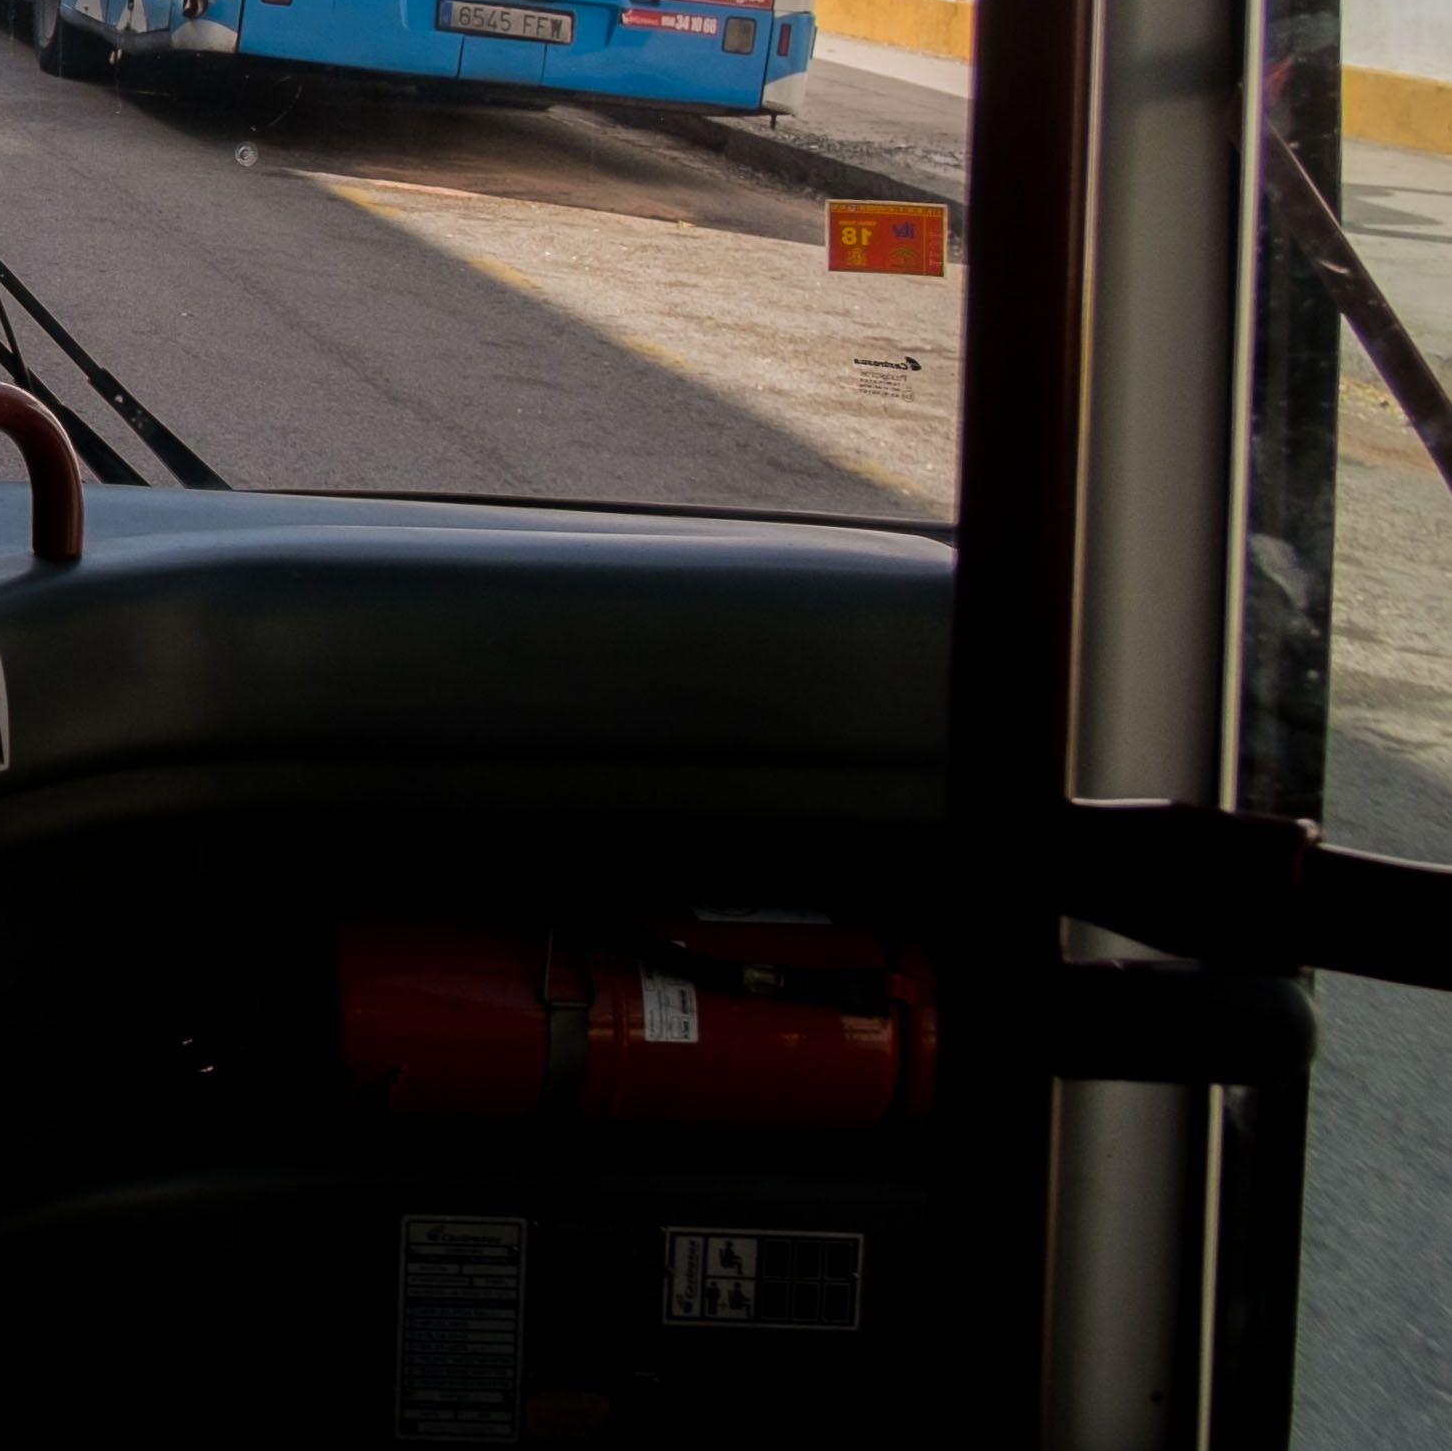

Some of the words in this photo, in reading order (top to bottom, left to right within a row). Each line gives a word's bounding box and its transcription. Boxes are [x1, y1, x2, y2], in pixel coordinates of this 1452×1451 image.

[458, 6, 512, 32] 6545
[521, 14, 565, 40] FFW
[675, 14, 690, 31] 34
[691, 16, 703, 32] 10
